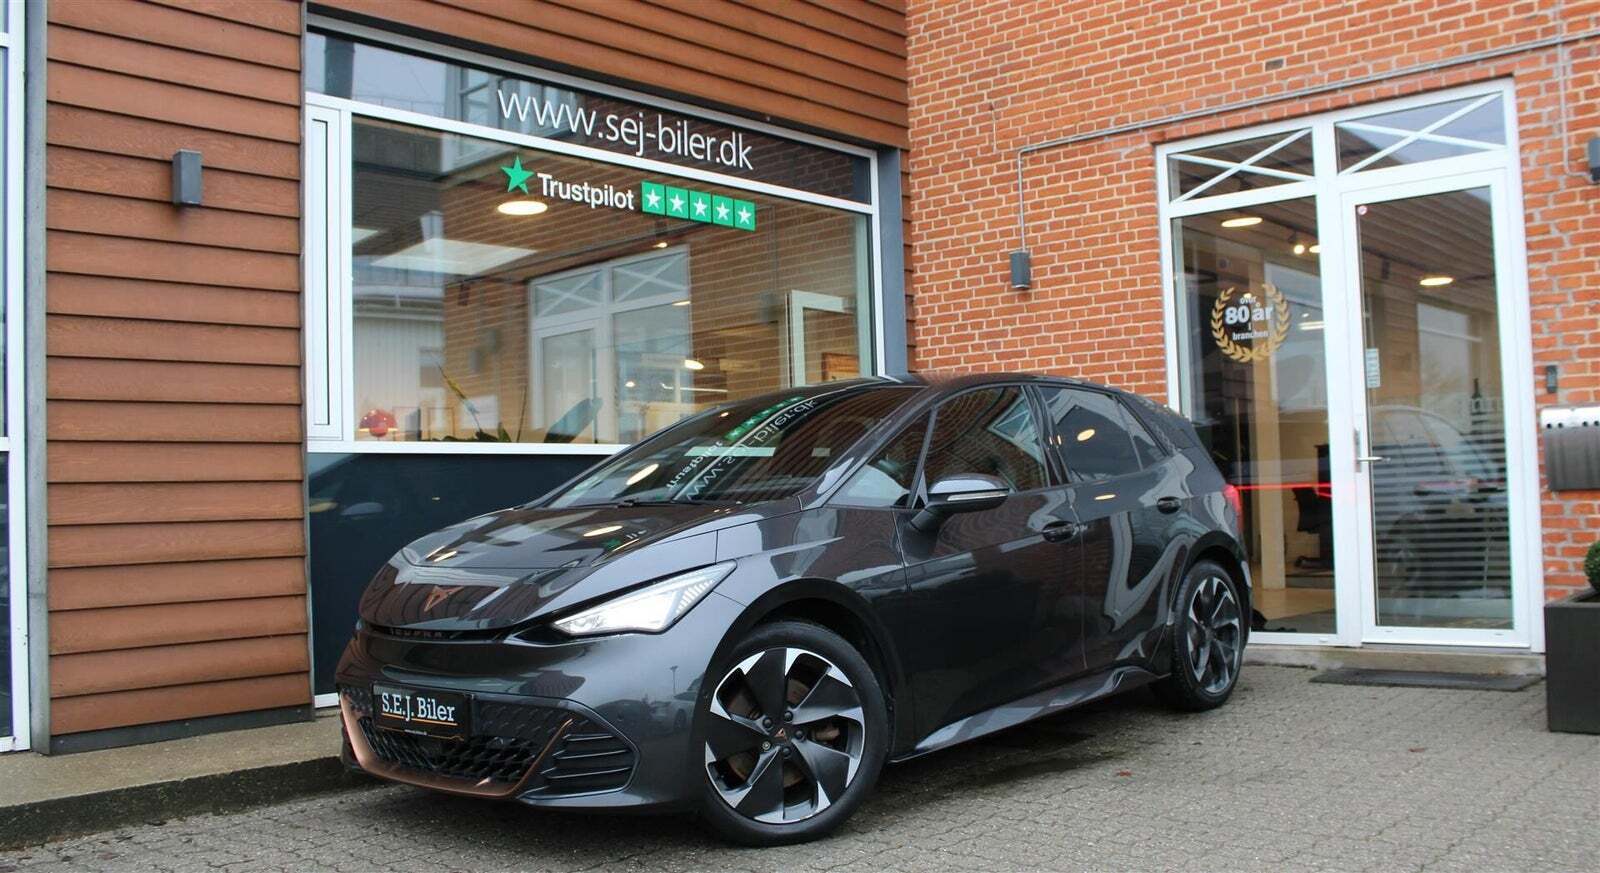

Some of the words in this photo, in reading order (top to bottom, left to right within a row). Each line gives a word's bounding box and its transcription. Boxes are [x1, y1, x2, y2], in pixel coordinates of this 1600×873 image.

[498, 89, 753, 170] www.sej-biler.dk
[537, 172, 635, 210] Trustpilot
[1225, 306, 1250, 325] 80
[1252, 302, 1273, 320] år
[382, 692, 414, 722] S.E.J.
[417, 697, 455, 722] Biler
